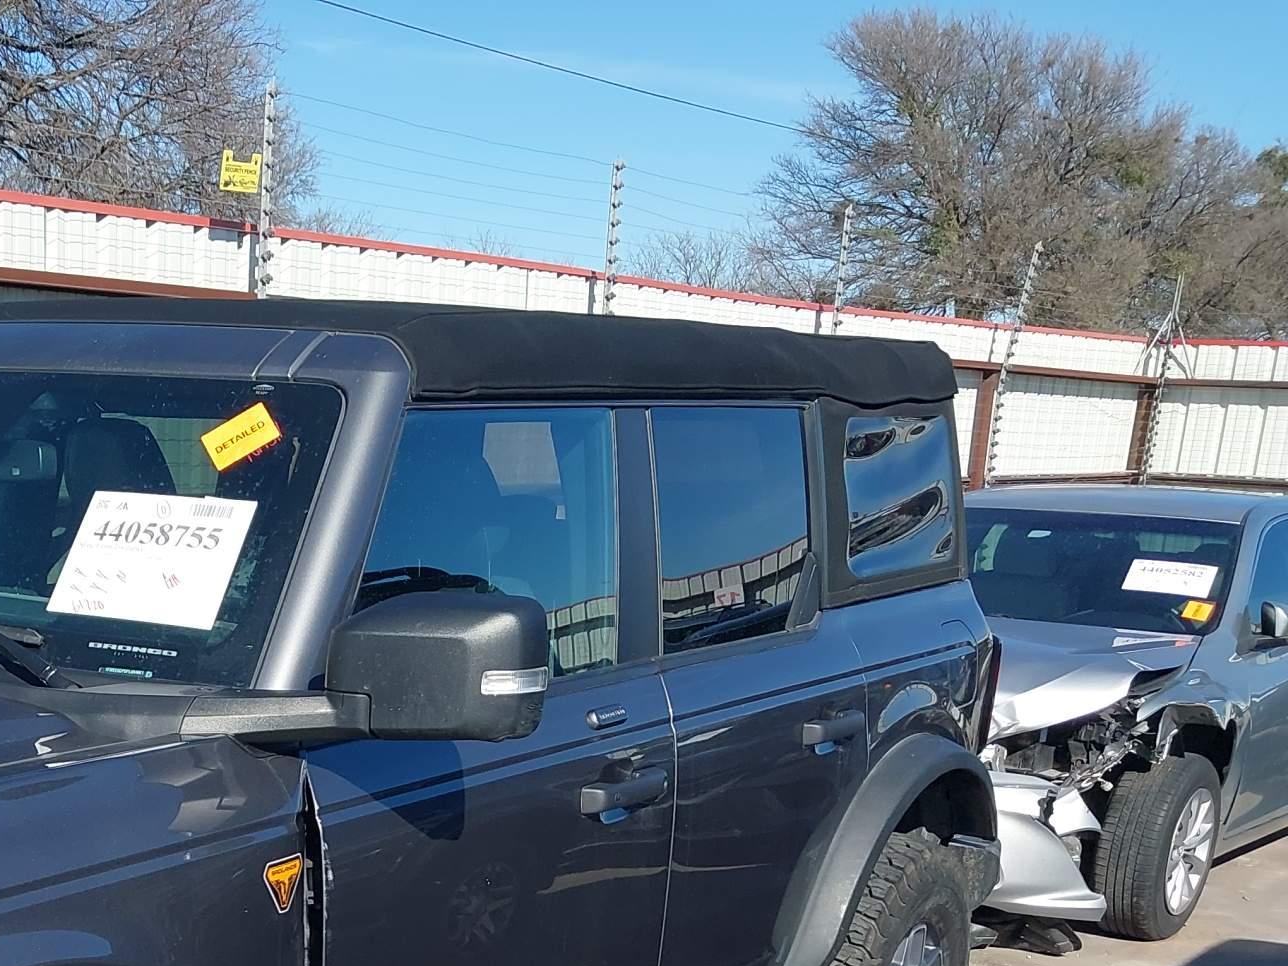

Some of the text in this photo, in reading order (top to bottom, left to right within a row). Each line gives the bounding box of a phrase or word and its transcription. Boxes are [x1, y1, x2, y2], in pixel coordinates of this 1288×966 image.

[214, 420, 265, 455] DETAILED
[94, 520, 223, 550] 44058755
[88, 641, 178, 657] BRONCO
